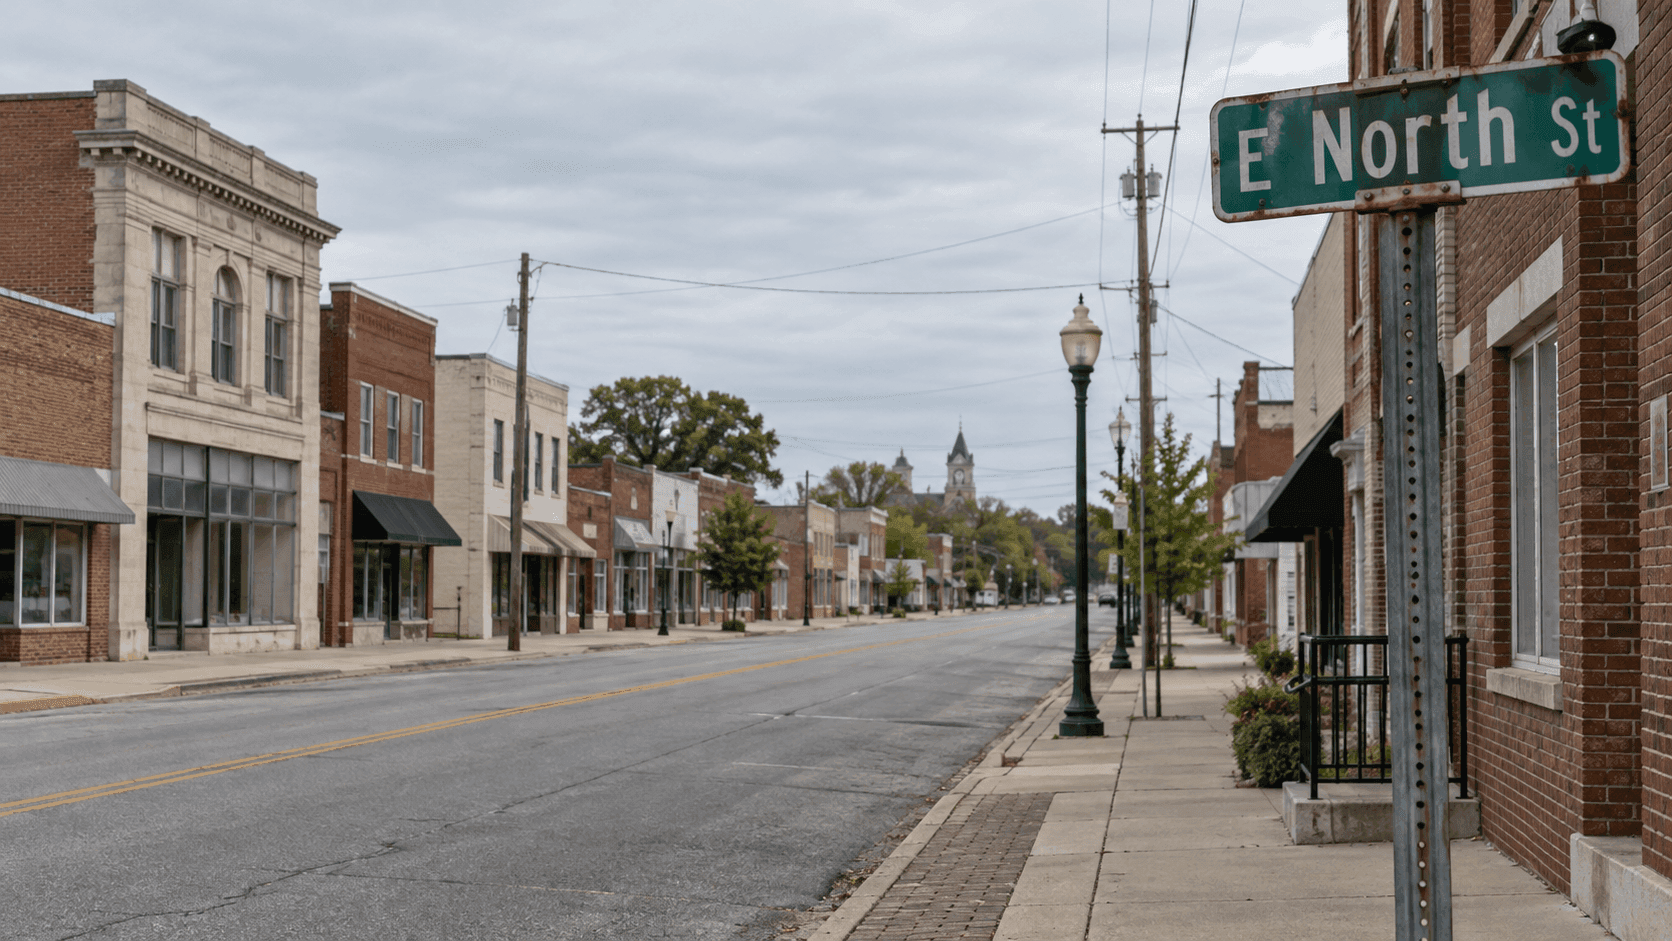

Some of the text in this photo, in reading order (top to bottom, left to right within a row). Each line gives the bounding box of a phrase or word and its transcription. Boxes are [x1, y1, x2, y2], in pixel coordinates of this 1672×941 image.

[1238, 88, 1602, 192] E North St
